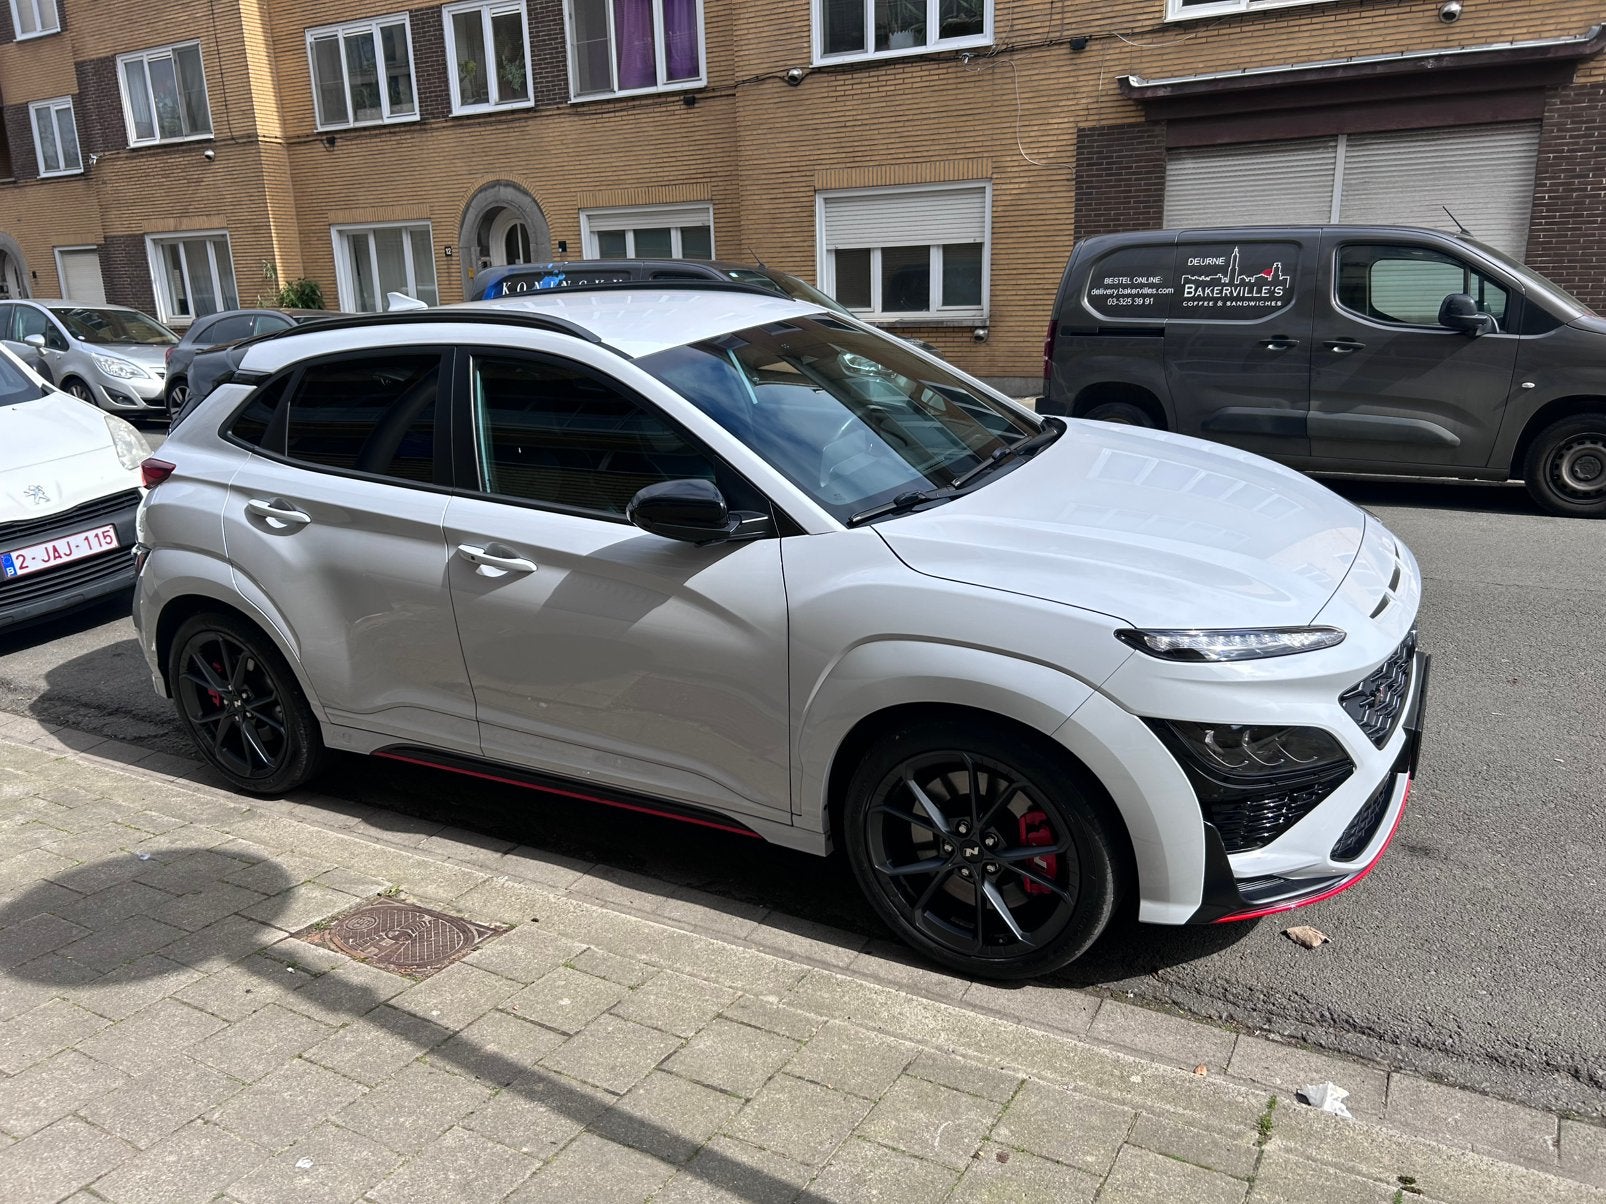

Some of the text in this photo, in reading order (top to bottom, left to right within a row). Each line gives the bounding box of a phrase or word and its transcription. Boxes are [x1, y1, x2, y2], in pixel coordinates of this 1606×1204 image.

[1187, 257, 1226, 266] DEURNE
[1104, 276, 1163, 285] BESTEL ONLINE:
[1091, 287, 1174, 296] delivery.bakervilles.com
[1107, 297, 1154, 306] 03-325 39 91
[15, 529, 114, 571] 2-JAJ-115
